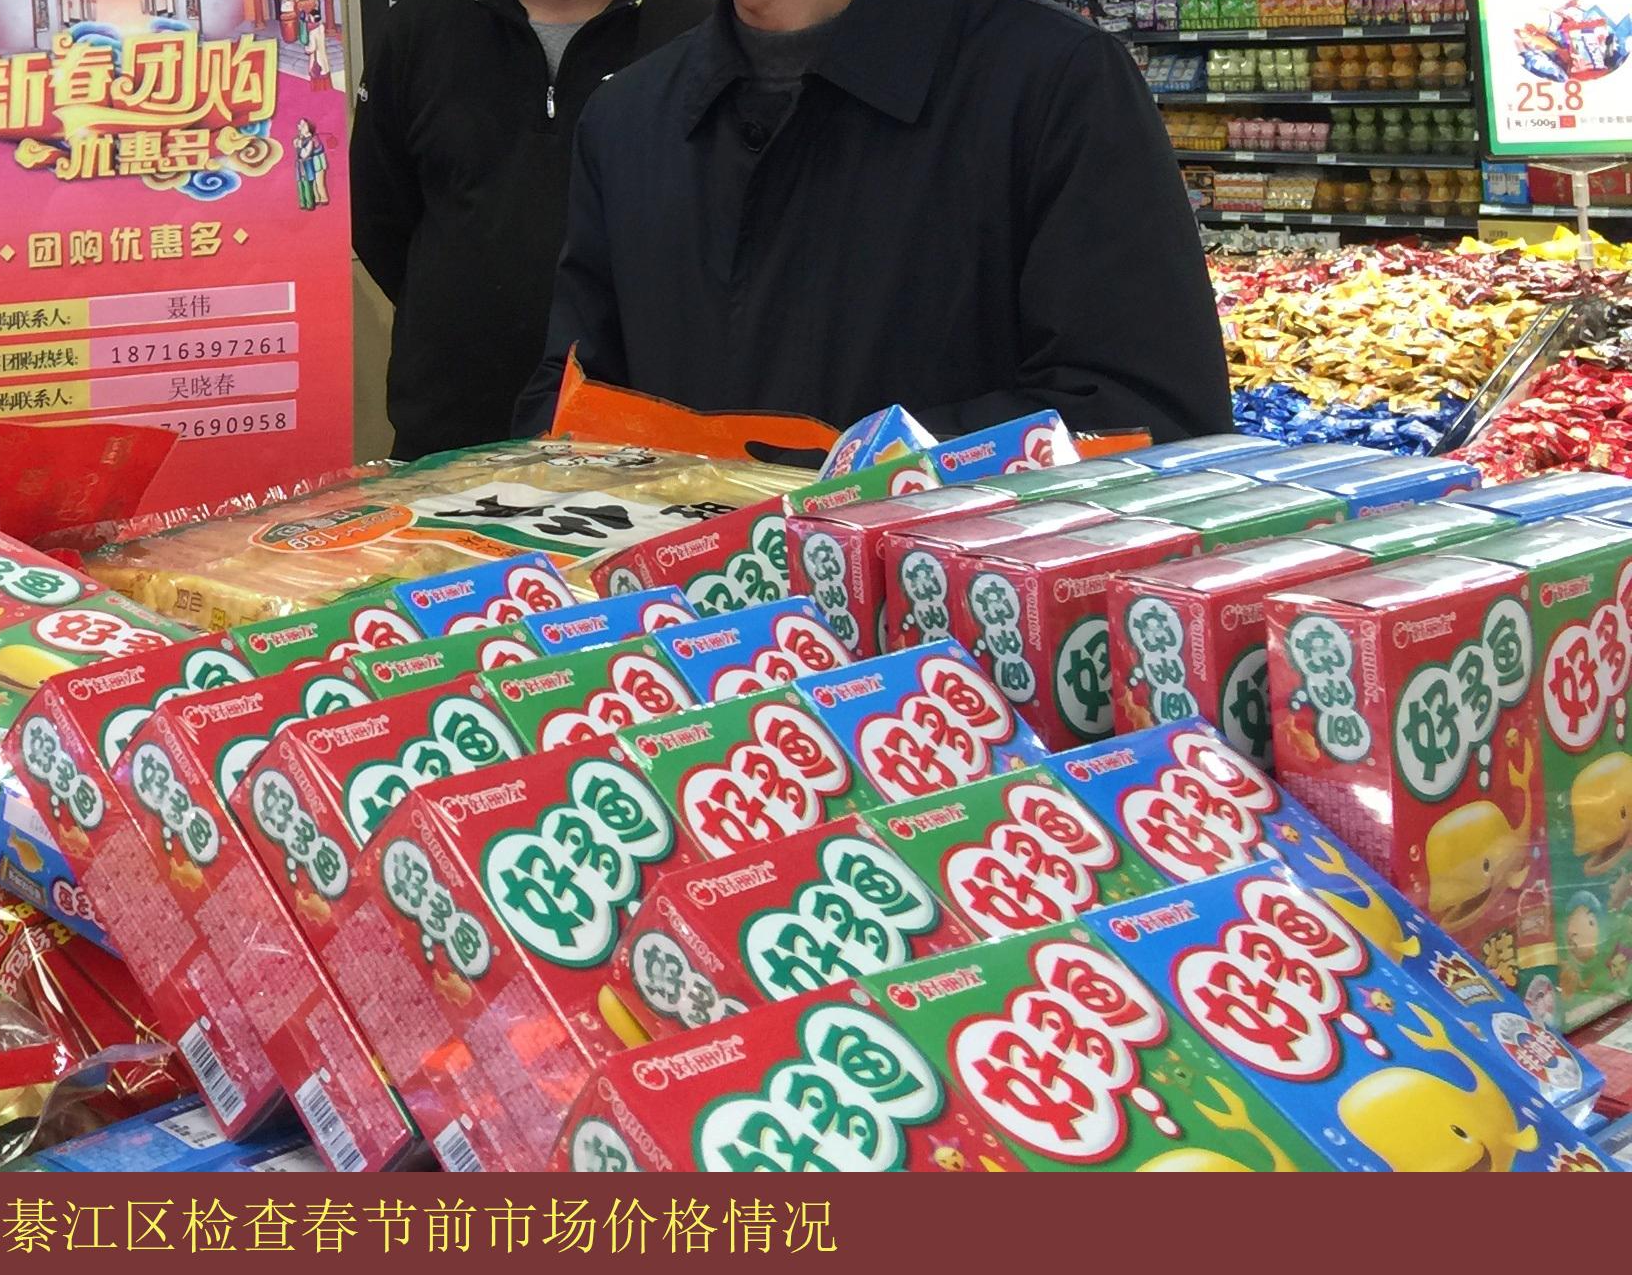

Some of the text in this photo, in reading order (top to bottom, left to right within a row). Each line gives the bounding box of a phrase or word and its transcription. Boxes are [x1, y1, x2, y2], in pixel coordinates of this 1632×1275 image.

[1516, 80, 1584, 113] 25.8
[28, 222, 223, 269] 团购优惠多
[110, 336, 288, 365] 18716397261
[167, 294, 212, 318] 聂伟
[168, 374, 236, 400] 吴晓春
[807, 538, 857, 641] 好多鱼
[905, 557, 949, 643] 好多
[974, 580, 1032, 692] 好多鱼
[1135, 606, 1193, 719] 好多鱼
[1296, 624, 1365, 749] 好多鱼
[1401, 613, 1526, 782] 好多鱼
[27, 719, 99, 821] 好多鱼
[875, 667, 1002, 798] 好多鱼
[136, 748, 216, 853] 好多鱼
[257, 775, 347, 891] 好多鱼
[387, 848, 490, 976] 好多鱼
[506, 774, 651, 947] 好多鱼
[964, 793, 1107, 936] 好多鱼
[1139, 900, 1200, 936] 好丽友
[916, 968, 984, 999] 好丽友
[1196, 886, 1351, 1064] 好多鱼
[973, 950, 1146, 1144] 好多鱼
